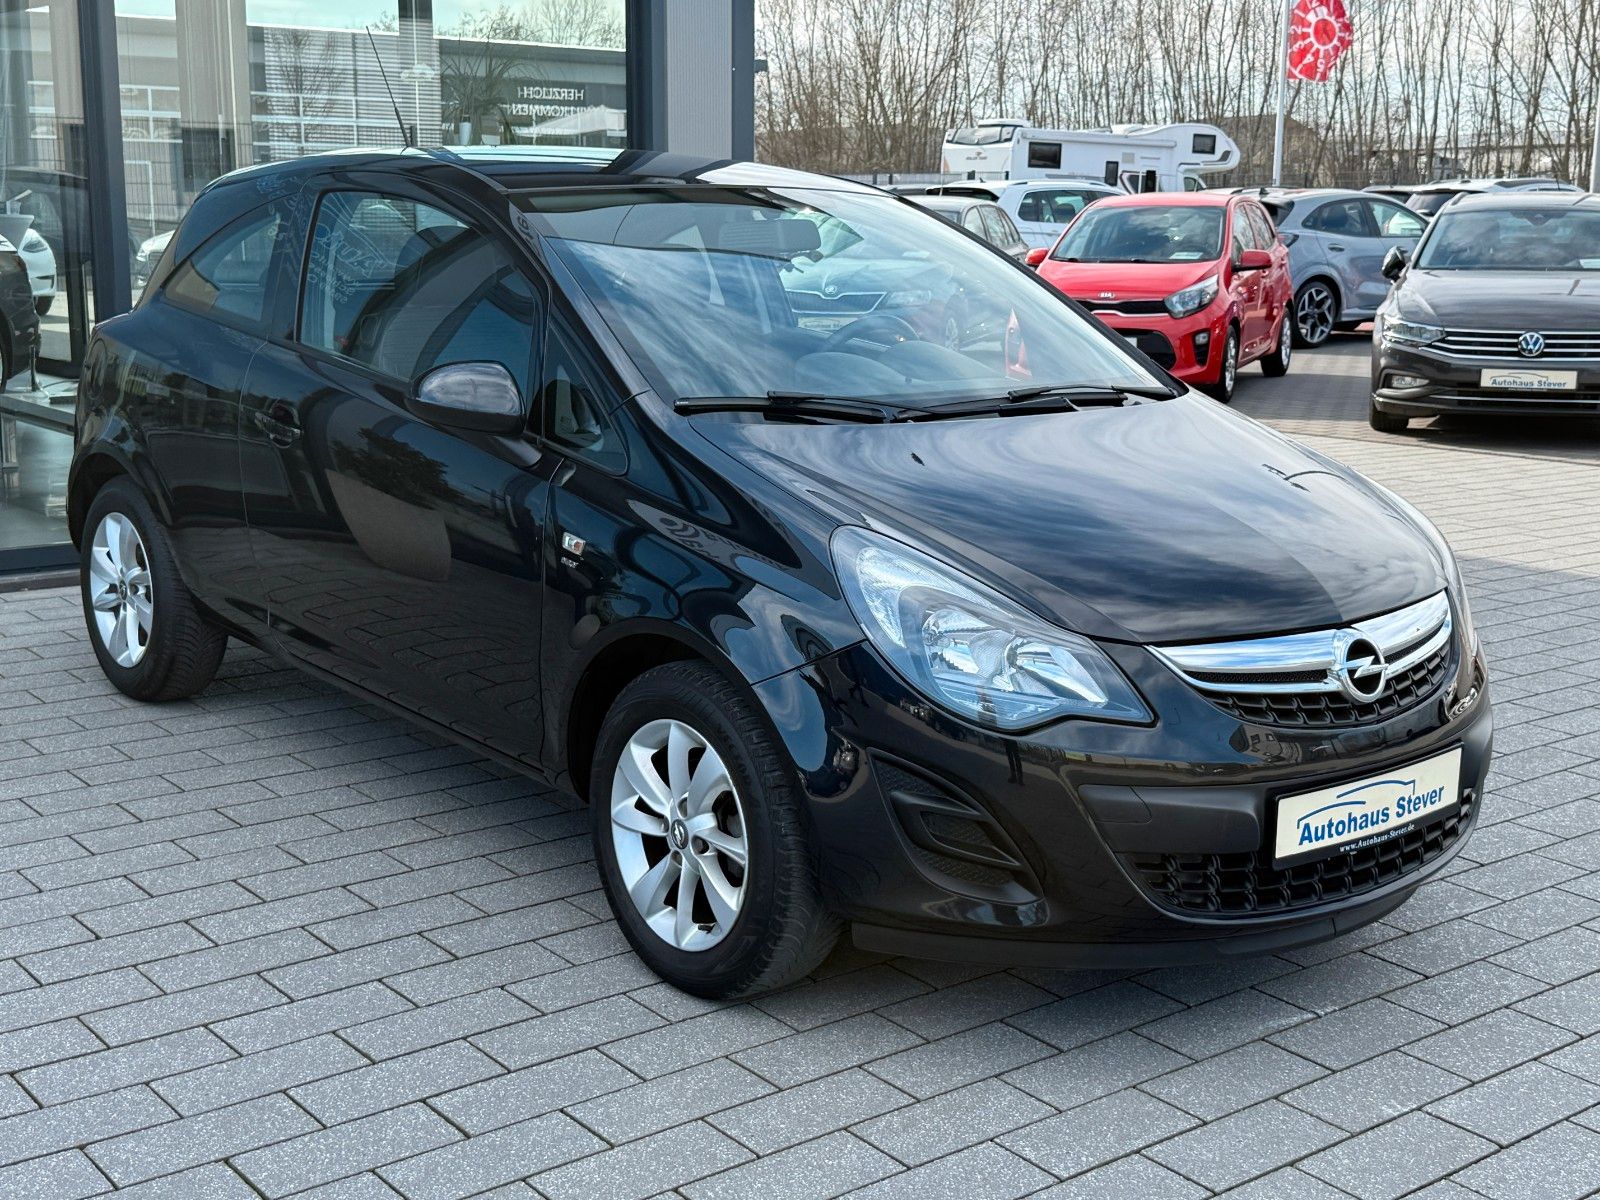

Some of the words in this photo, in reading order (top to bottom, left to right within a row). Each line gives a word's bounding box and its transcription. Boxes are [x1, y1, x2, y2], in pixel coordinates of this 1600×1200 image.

[1491, 378, 1534, 387] Autohaus
[1537, 379, 1567, 388] Stever
[1298, 806, 1390, 845] Autohaus
[1395, 785, 1445, 819] Stever
[1339, 822, 1416, 852] www.Autohaus-Stever.de
